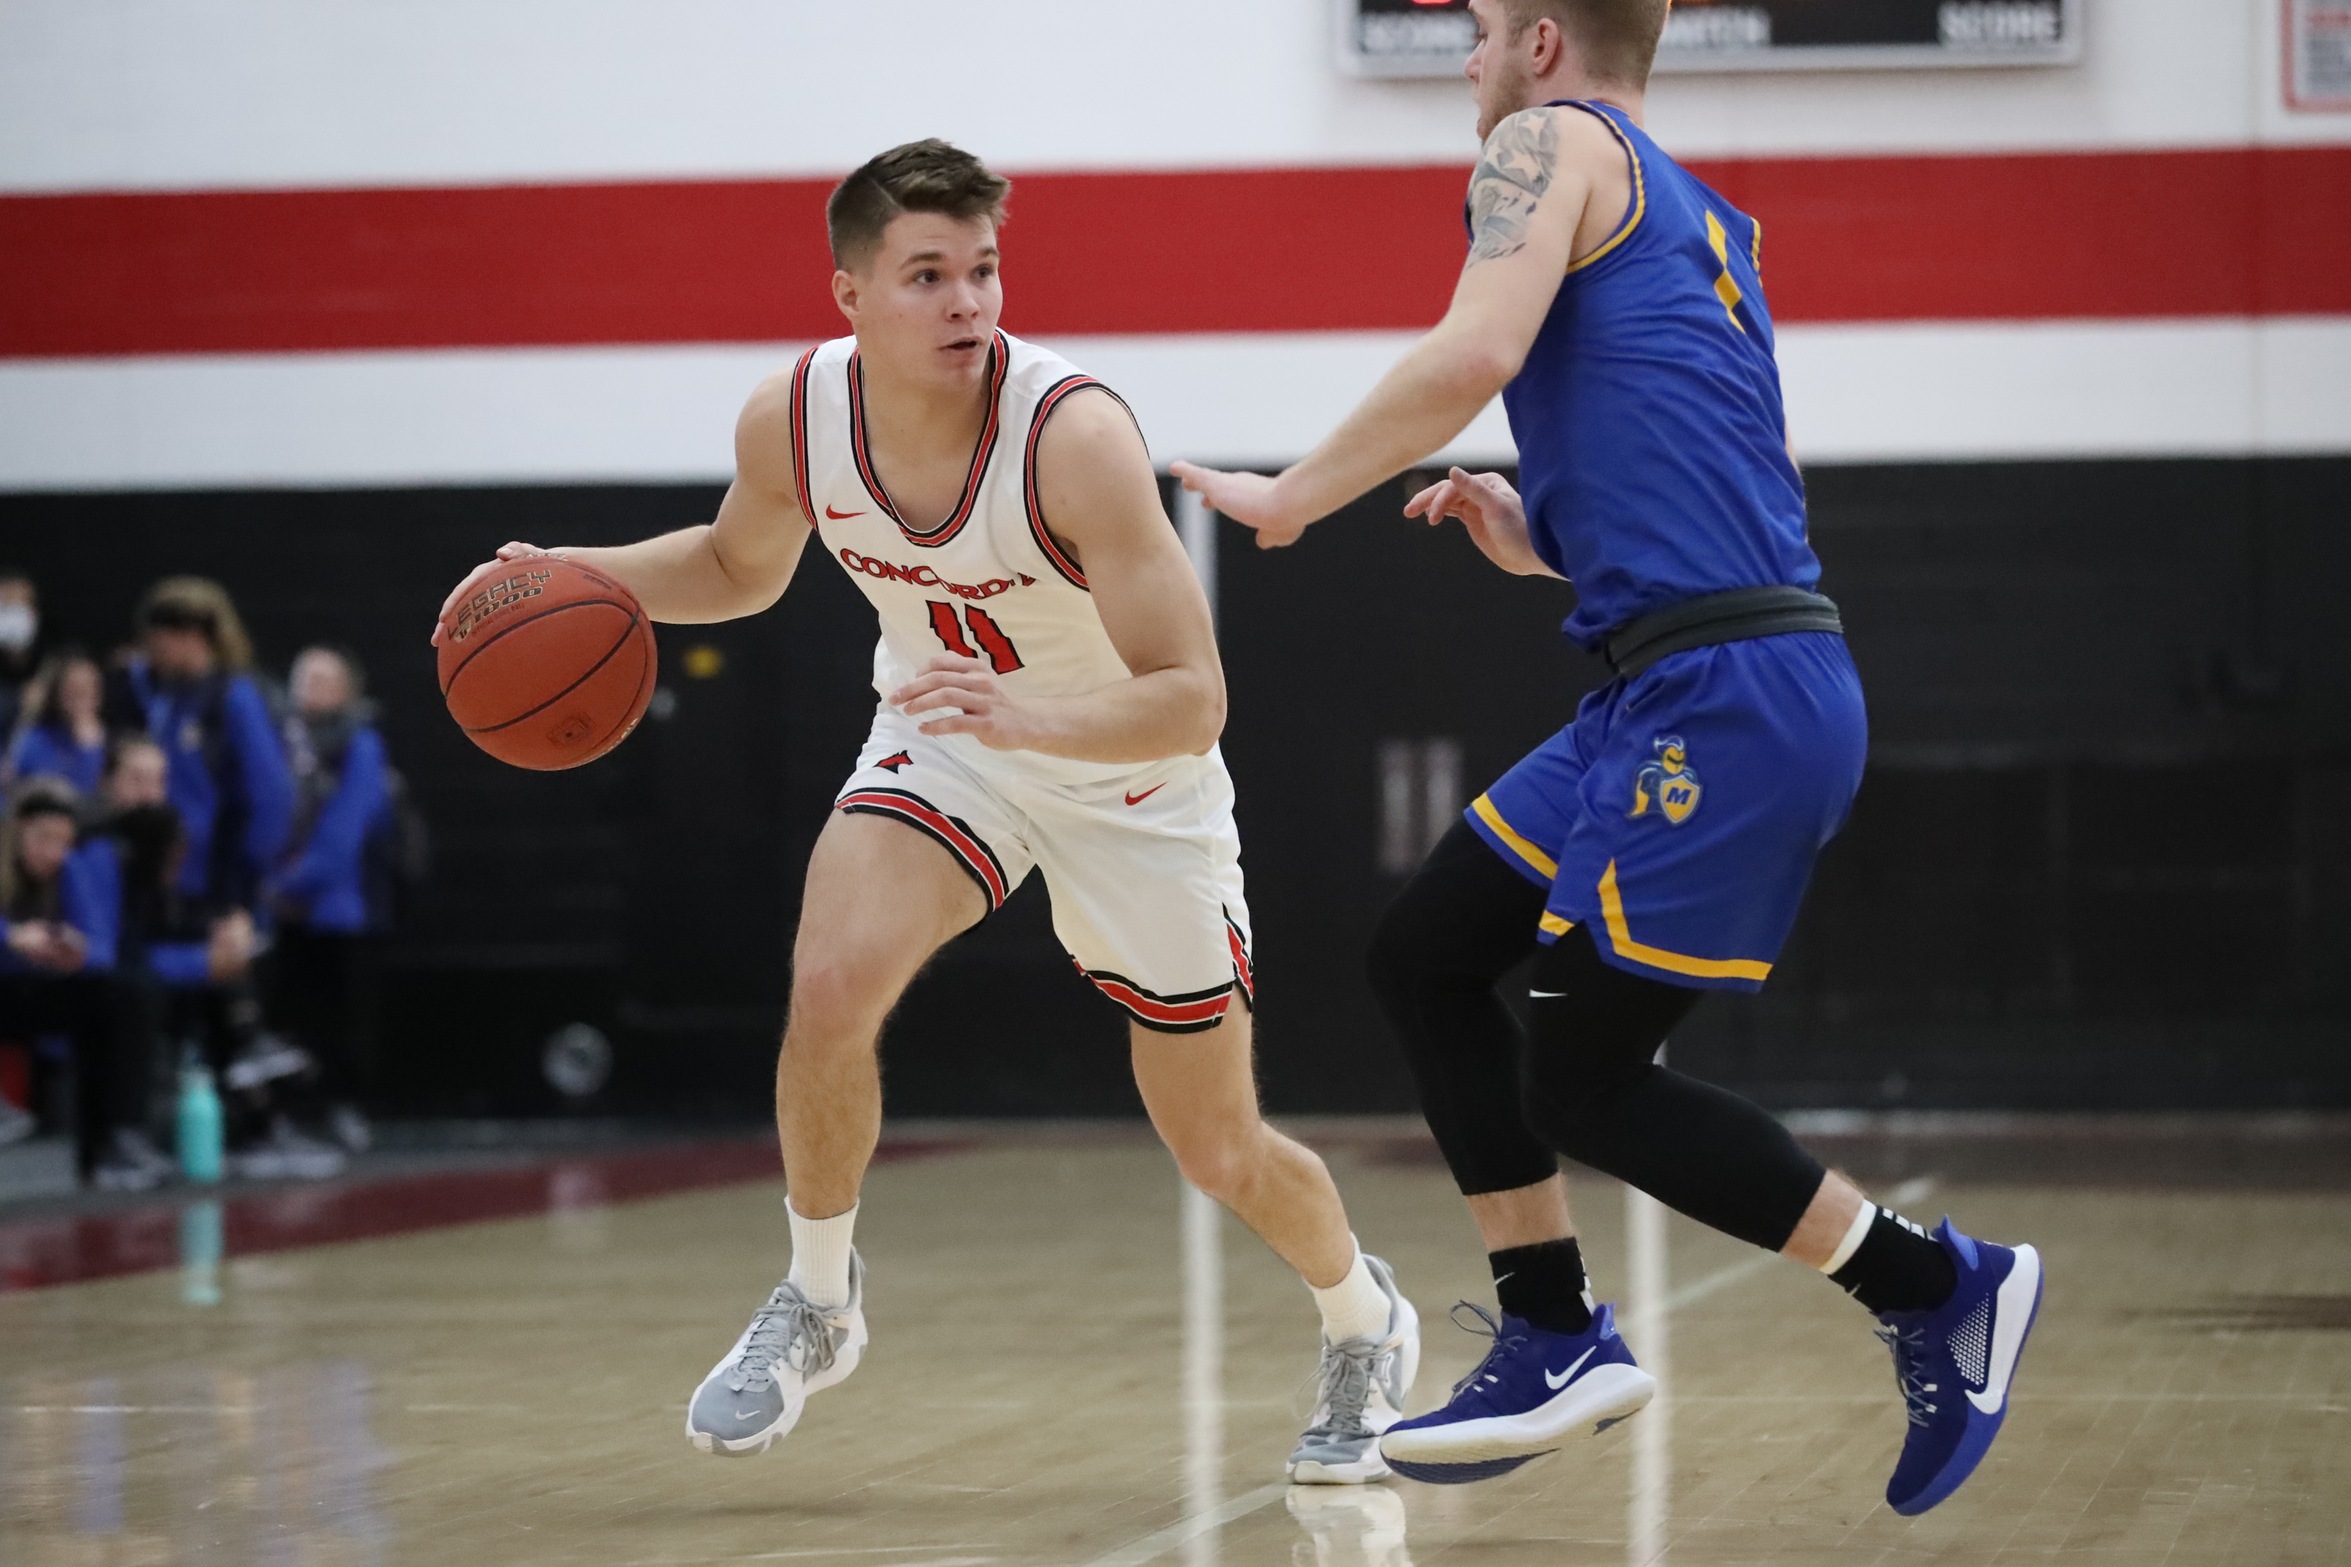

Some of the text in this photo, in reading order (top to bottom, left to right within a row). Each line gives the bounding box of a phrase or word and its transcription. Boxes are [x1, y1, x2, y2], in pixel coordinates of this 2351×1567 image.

[840, 547, 1037, 600] CONCORD
[925, 600, 1025, 675] 11
[1666, 787, 1692, 805] M
